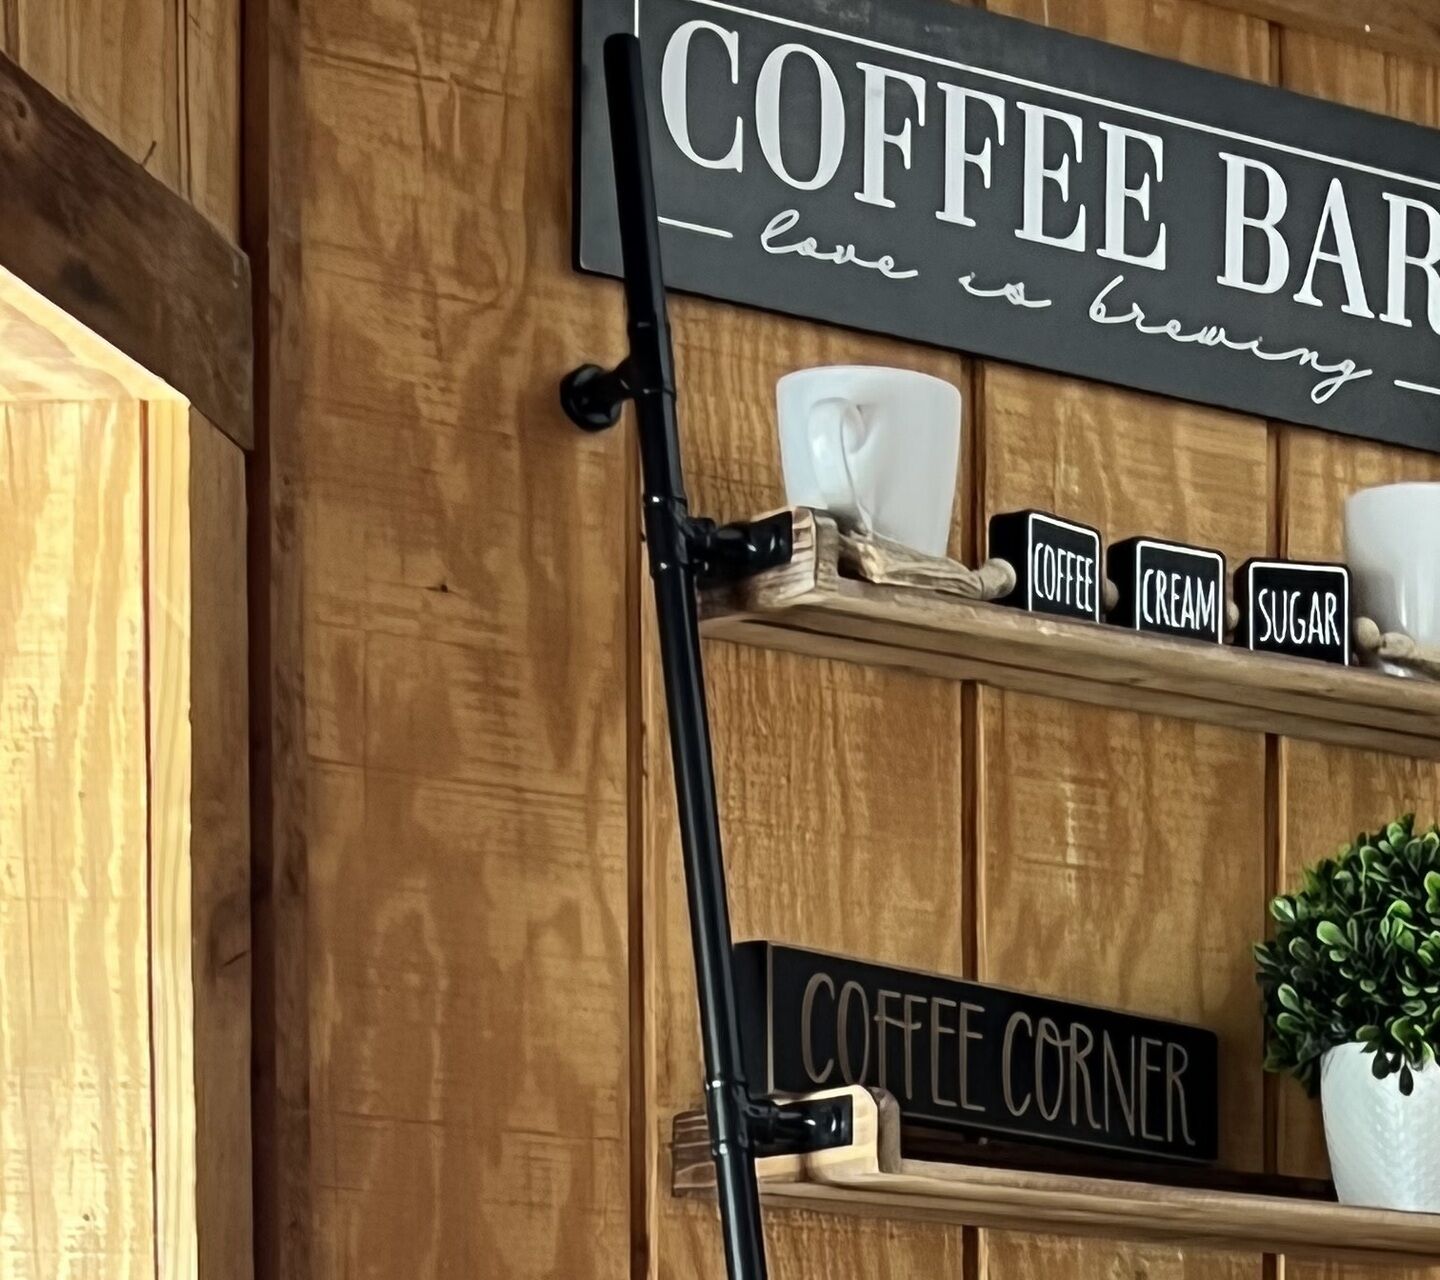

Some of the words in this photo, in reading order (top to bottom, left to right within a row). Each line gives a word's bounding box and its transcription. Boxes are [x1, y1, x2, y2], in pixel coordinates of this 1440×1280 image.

[660, 20, 1168, 271] COFFEE
[760, 208, 920, 280] love
[957, 270, 1052, 309] is
[1088, 274, 1374, 405] brewing
[1033, 541, 1095, 614] COFFEE
[1142, 567, 1218, 637] CREAM
[1257, 586, 1341, 647] SUGAR
[802, 973, 986, 1111] COFFEE
[1002, 1012, 1195, 1146] CORNER
